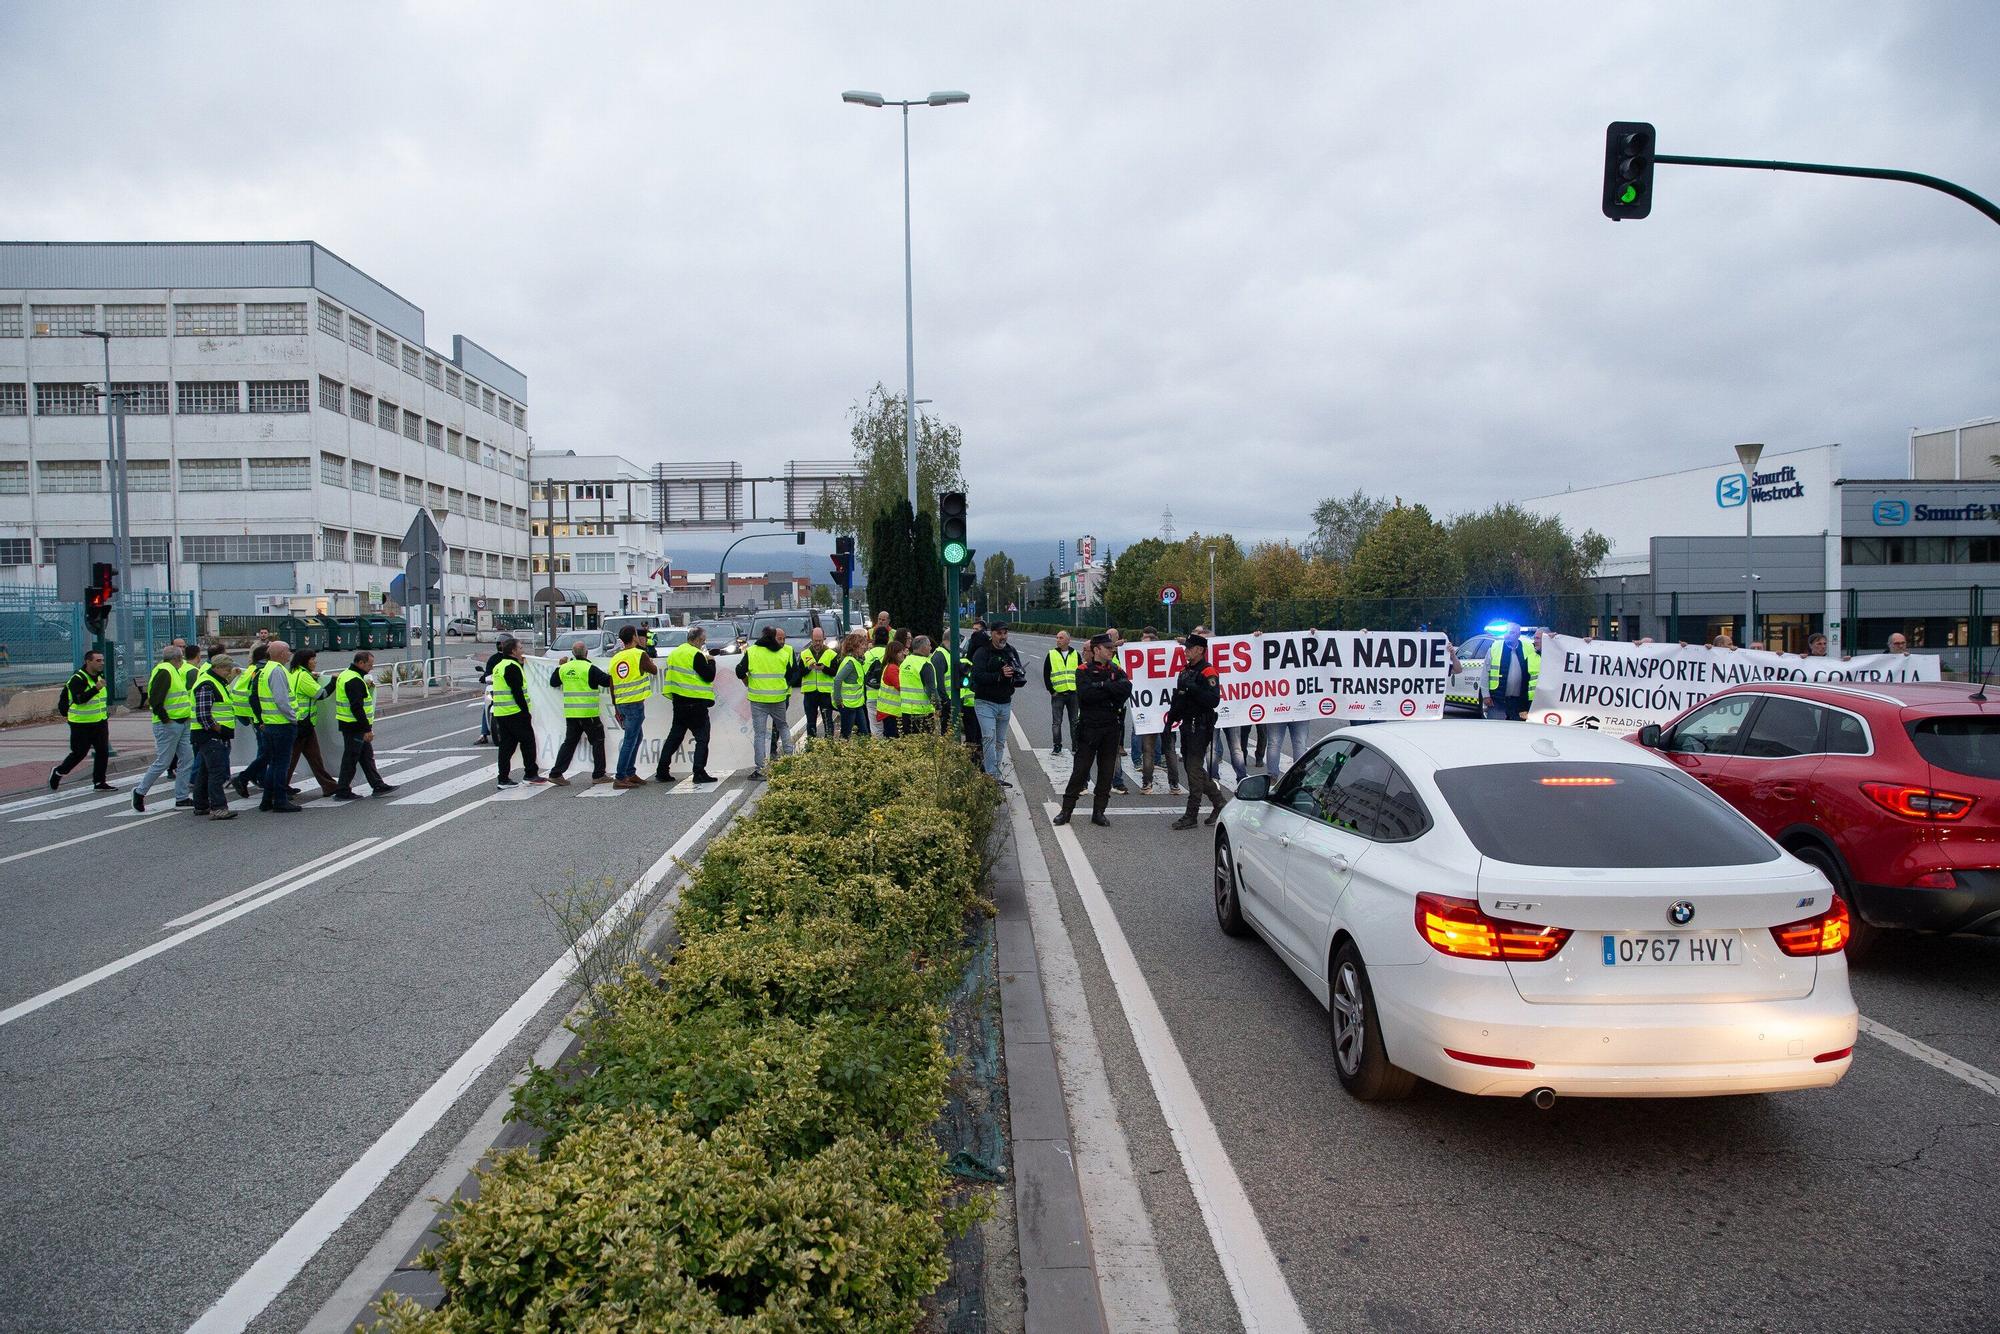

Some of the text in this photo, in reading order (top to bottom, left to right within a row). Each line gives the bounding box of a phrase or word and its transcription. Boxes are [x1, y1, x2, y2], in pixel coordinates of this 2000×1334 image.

[1752, 466, 1796, 487] Smurfit
[1752, 481, 1804, 502] Westrock
[1915, 503, 1986, 521] Smurfit
[1164, 591, 1176, 599] 50
[1124, 637, 1447, 680] PEAES PARA NADIE
[1564, 652, 1583, 673] EL
[1589, 653, 1707, 682] TRANSPORTE
[1711, 662, 1808, 684] NAVARRO
[1130, 689, 1153, 708] NO
[1296, 677, 1323, 696] DEL
[1330, 677, 1446, 695] TRANSPORTE
[1559, 682, 1682, 711] IMPOSICIÓN
[1274, 705, 1291, 713] HIRU
[1348, 703, 1366, 711] HIRU
[1495, 900, 1542, 911] GT
[1619, 939, 1681, 962] 0767
[1689, 939, 1733, 962] HVY
